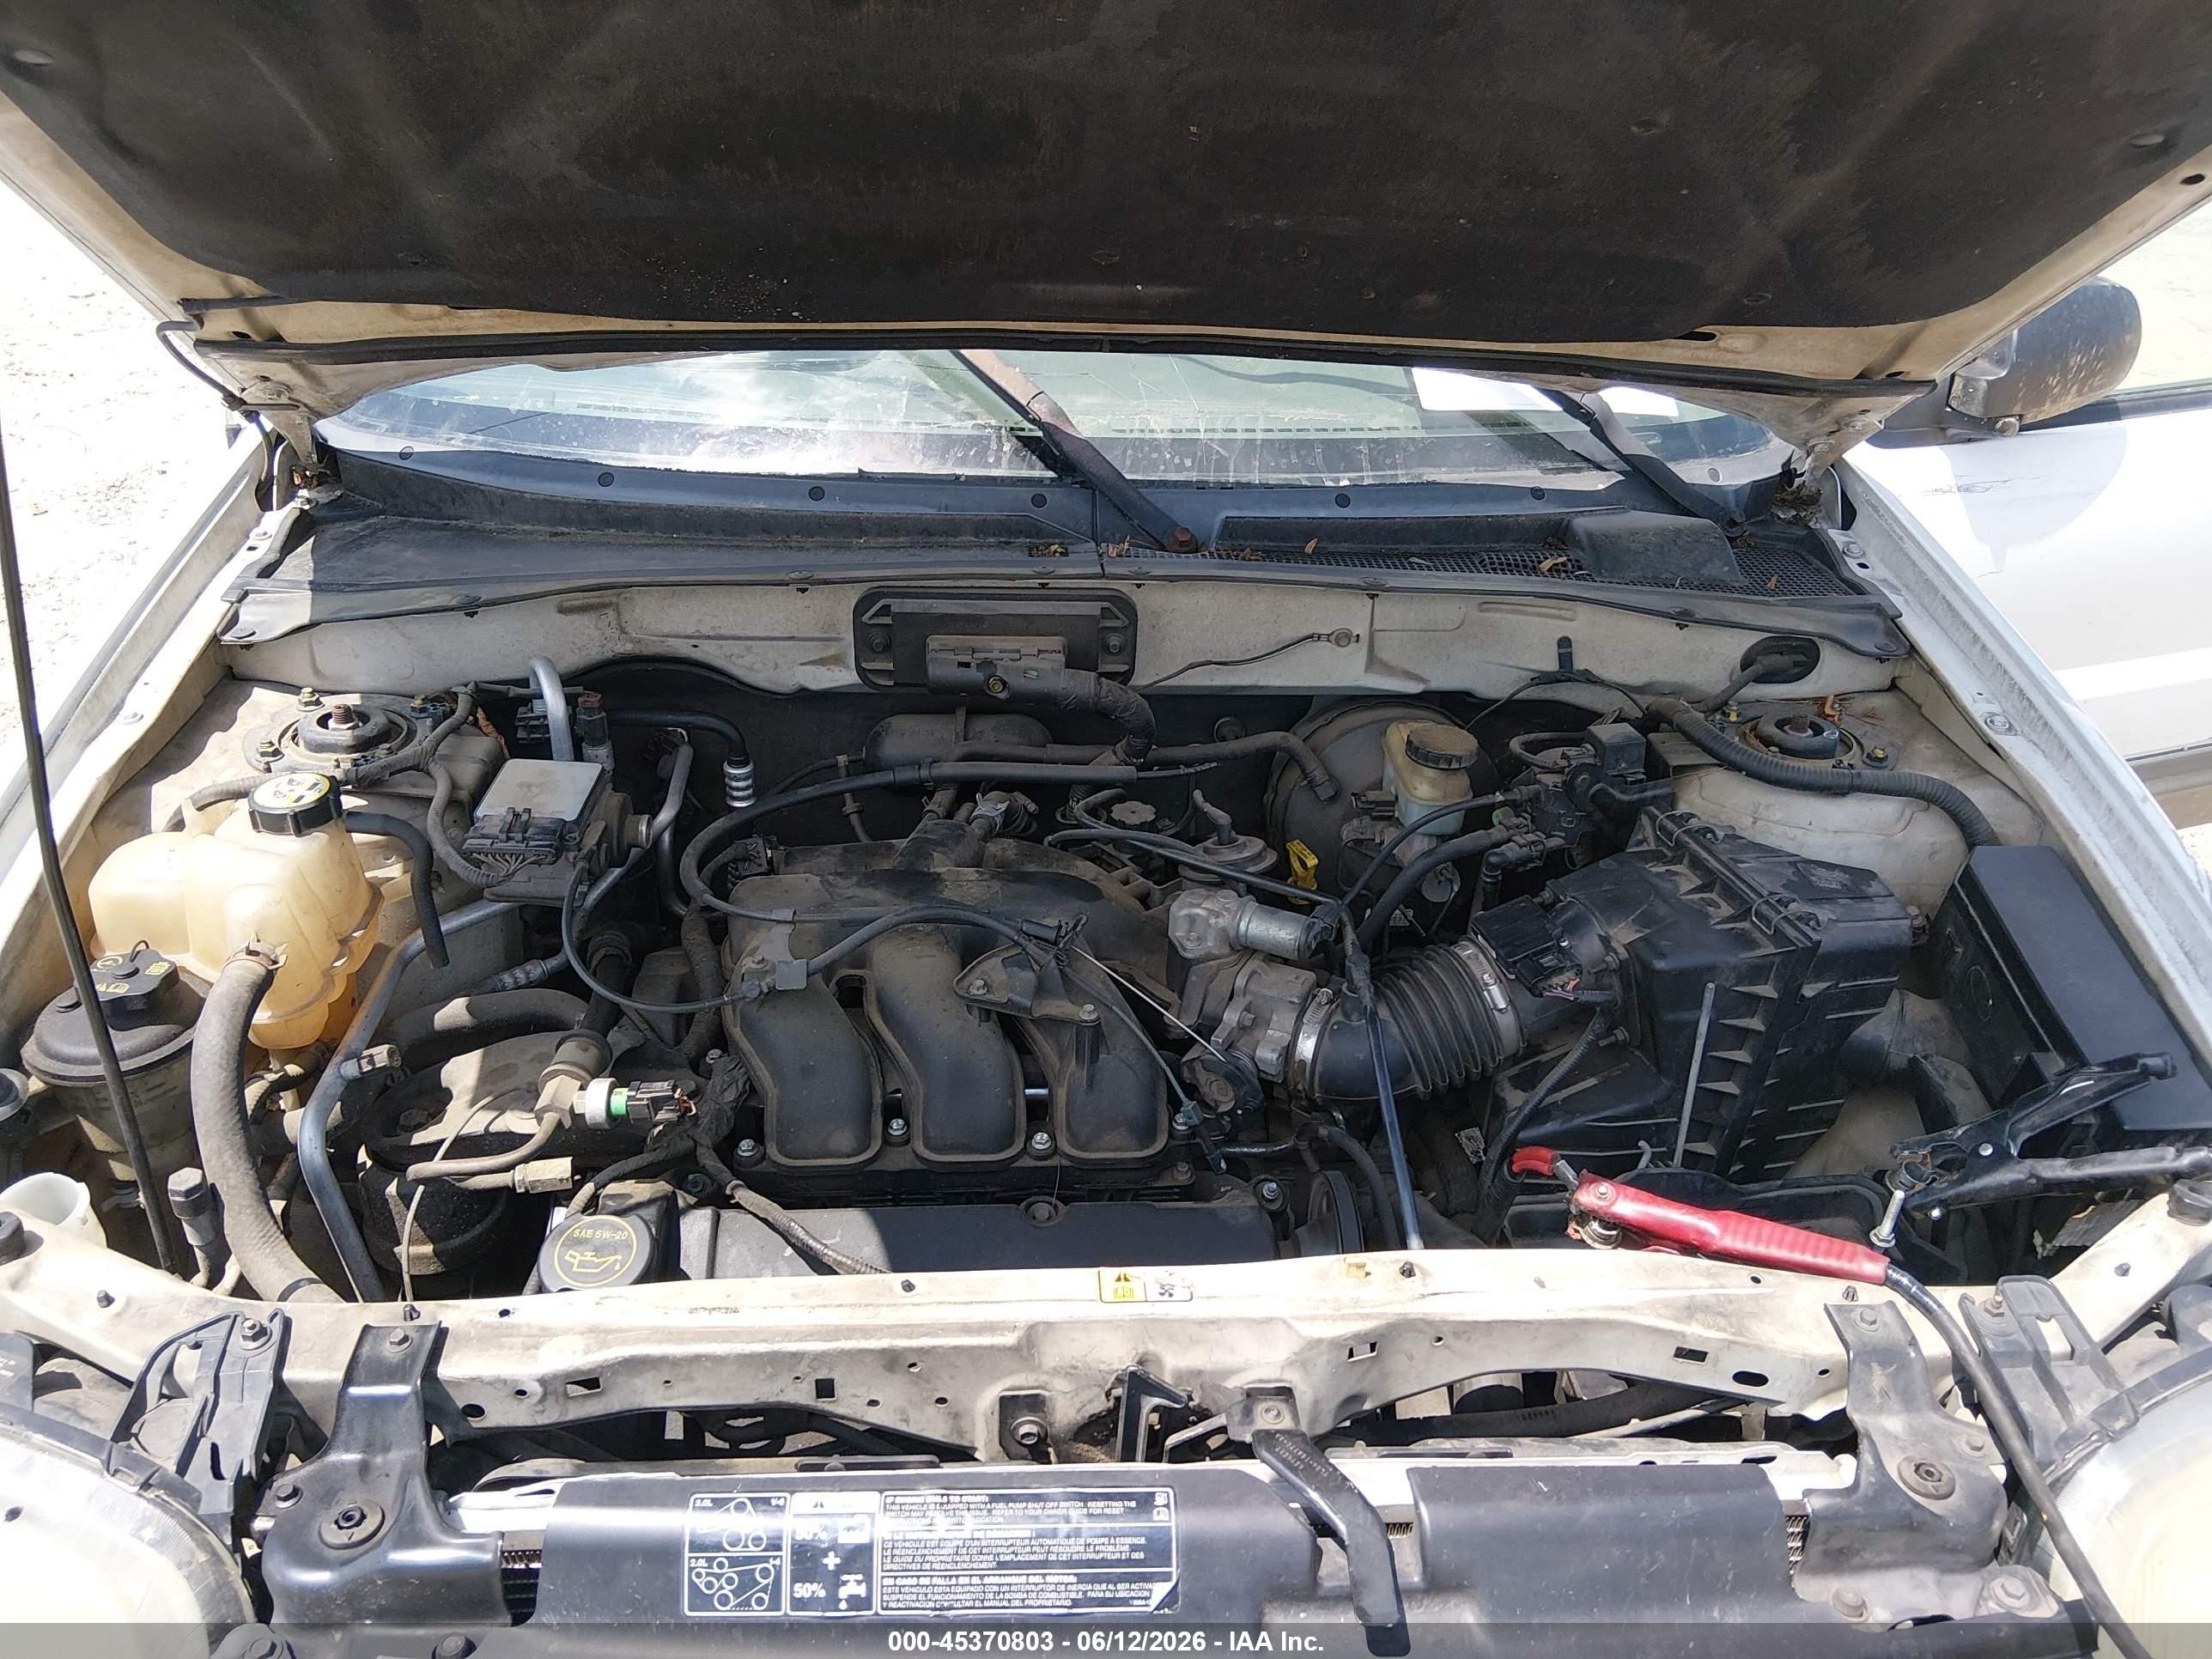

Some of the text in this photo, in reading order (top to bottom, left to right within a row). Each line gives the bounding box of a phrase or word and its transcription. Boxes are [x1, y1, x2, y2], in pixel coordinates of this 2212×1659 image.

[573, 1230, 628, 1240] SAE 5W-20
[981, 1538, 1030, 1547] INTERRUPTEUR
[1030, 1537, 1074, 1546] AUTOMATIQUE
[1072, 1552, 1121, 1560] INTERRUPTEUR
[690, 1559, 708, 1567] 2.0L
[793, 1583, 826, 1598] 50%
